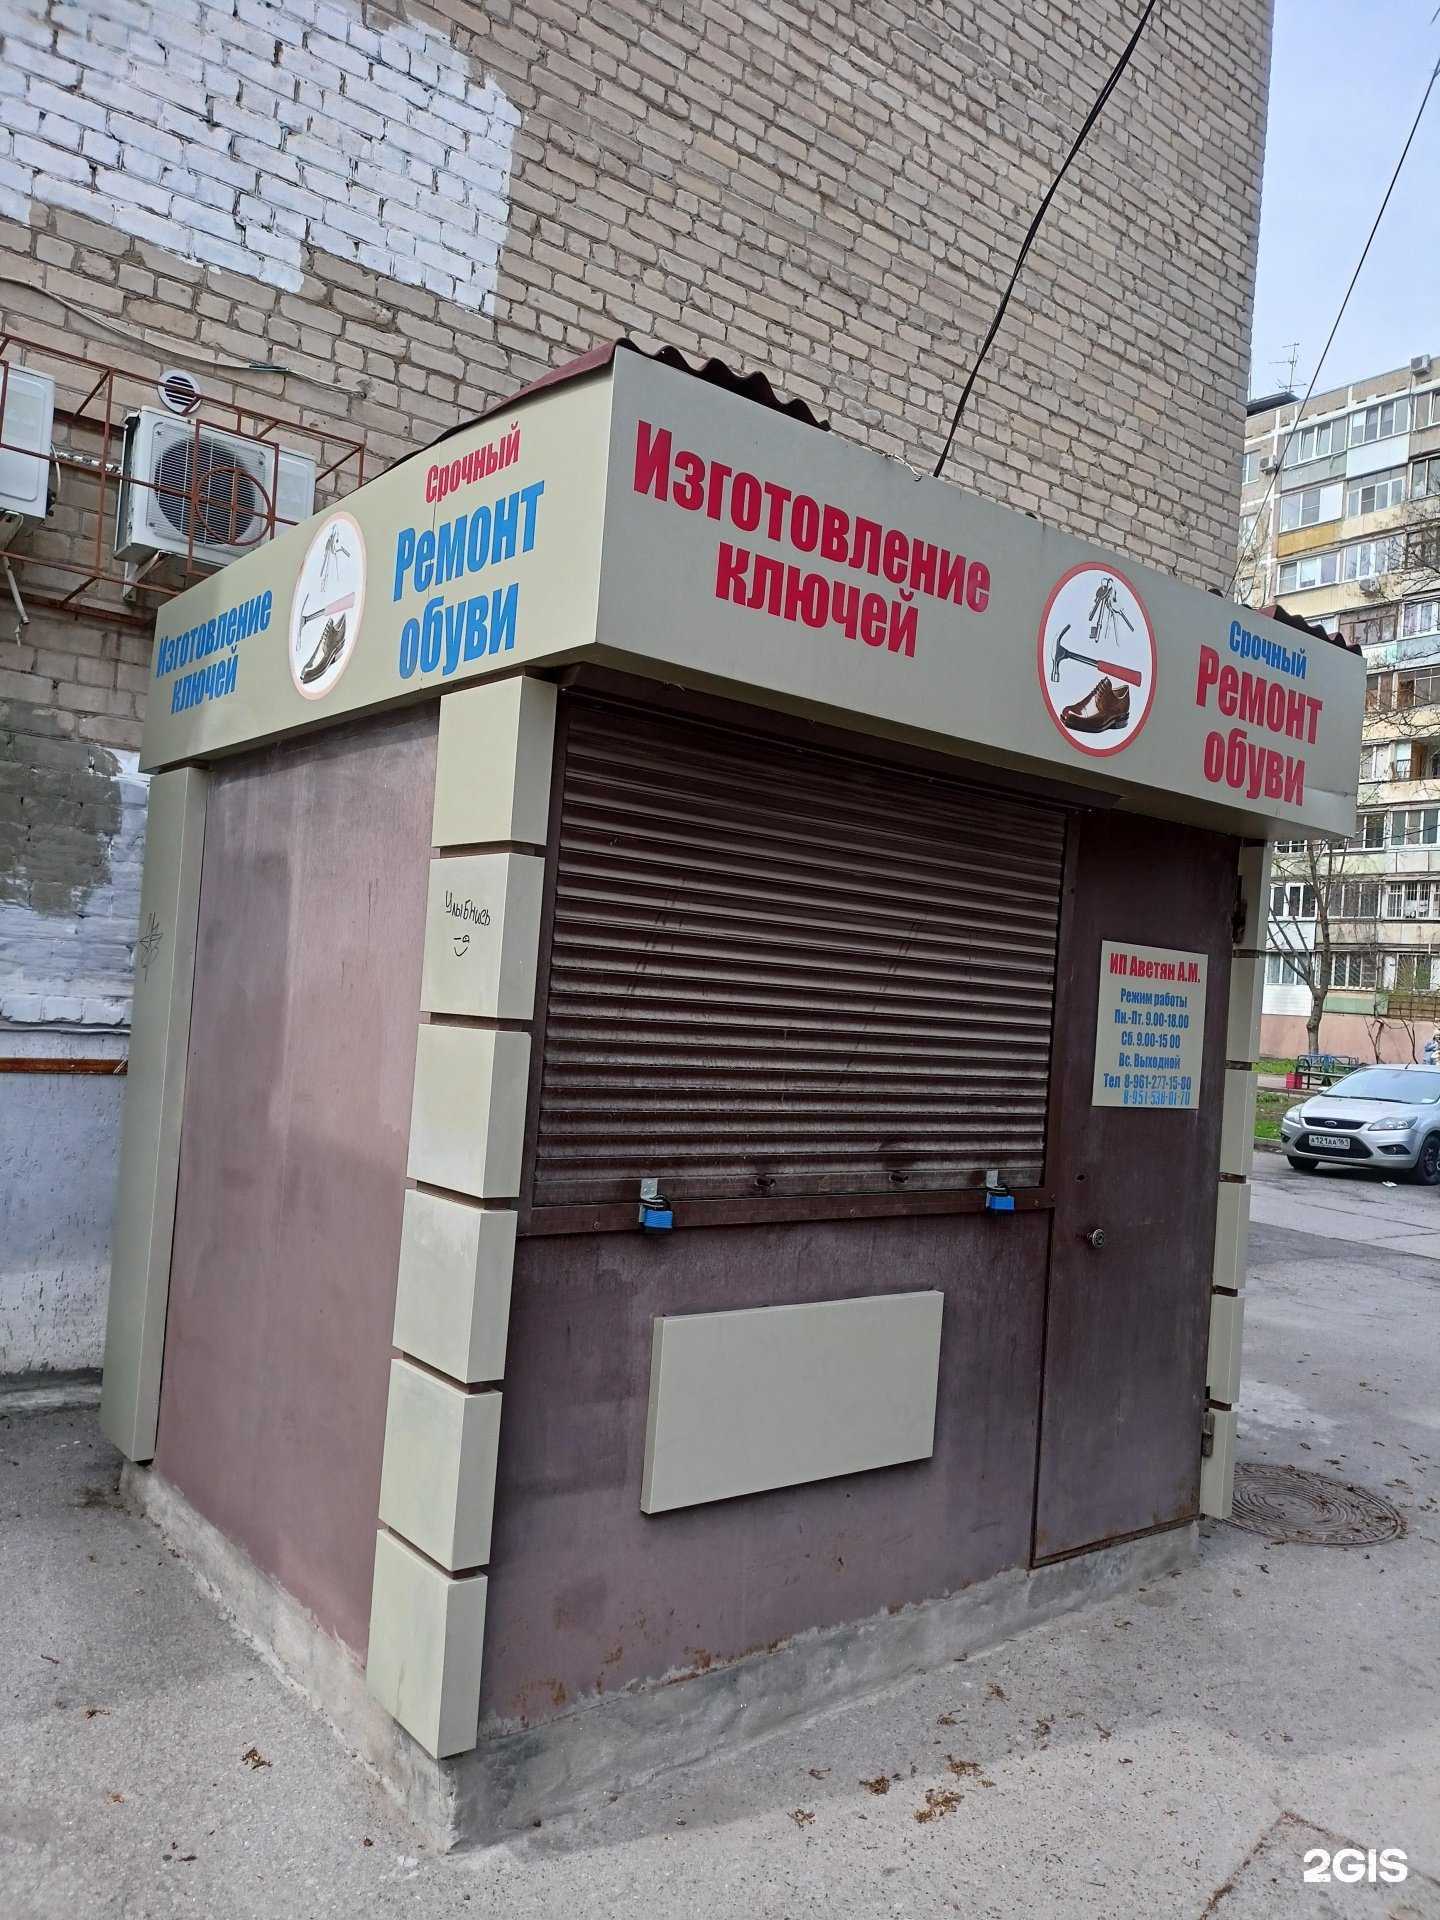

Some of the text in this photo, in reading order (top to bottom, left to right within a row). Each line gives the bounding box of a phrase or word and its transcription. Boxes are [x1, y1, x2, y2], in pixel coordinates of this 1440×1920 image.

[424, 421, 521, 503] Срочный
[393, 480, 545, 601] Ремонт
[633, 419, 992, 614] Изготовление
[155, 589, 273, 679] Изготовление
[399, 583, 519, 680] обуви
[714, 541, 919, 658] ключей
[170, 646, 239, 714] ключей
[1229, 620, 1307, 680] Срочный
[1196, 644, 1323, 744] Ремонт
[1203, 727, 1305, 806] обуви
[445, 890, 491, 926] Улыбнись
[1109, 953, 1128, 975] ИП
[1120, 988, 1188, 1008] Режим работы
[1121, 1031, 1135, 1046] Сб.
[1145, 1012, 1189, 1029] 9.00-18.00
[1118, 1052, 1181, 1070] Вс. Выходной
